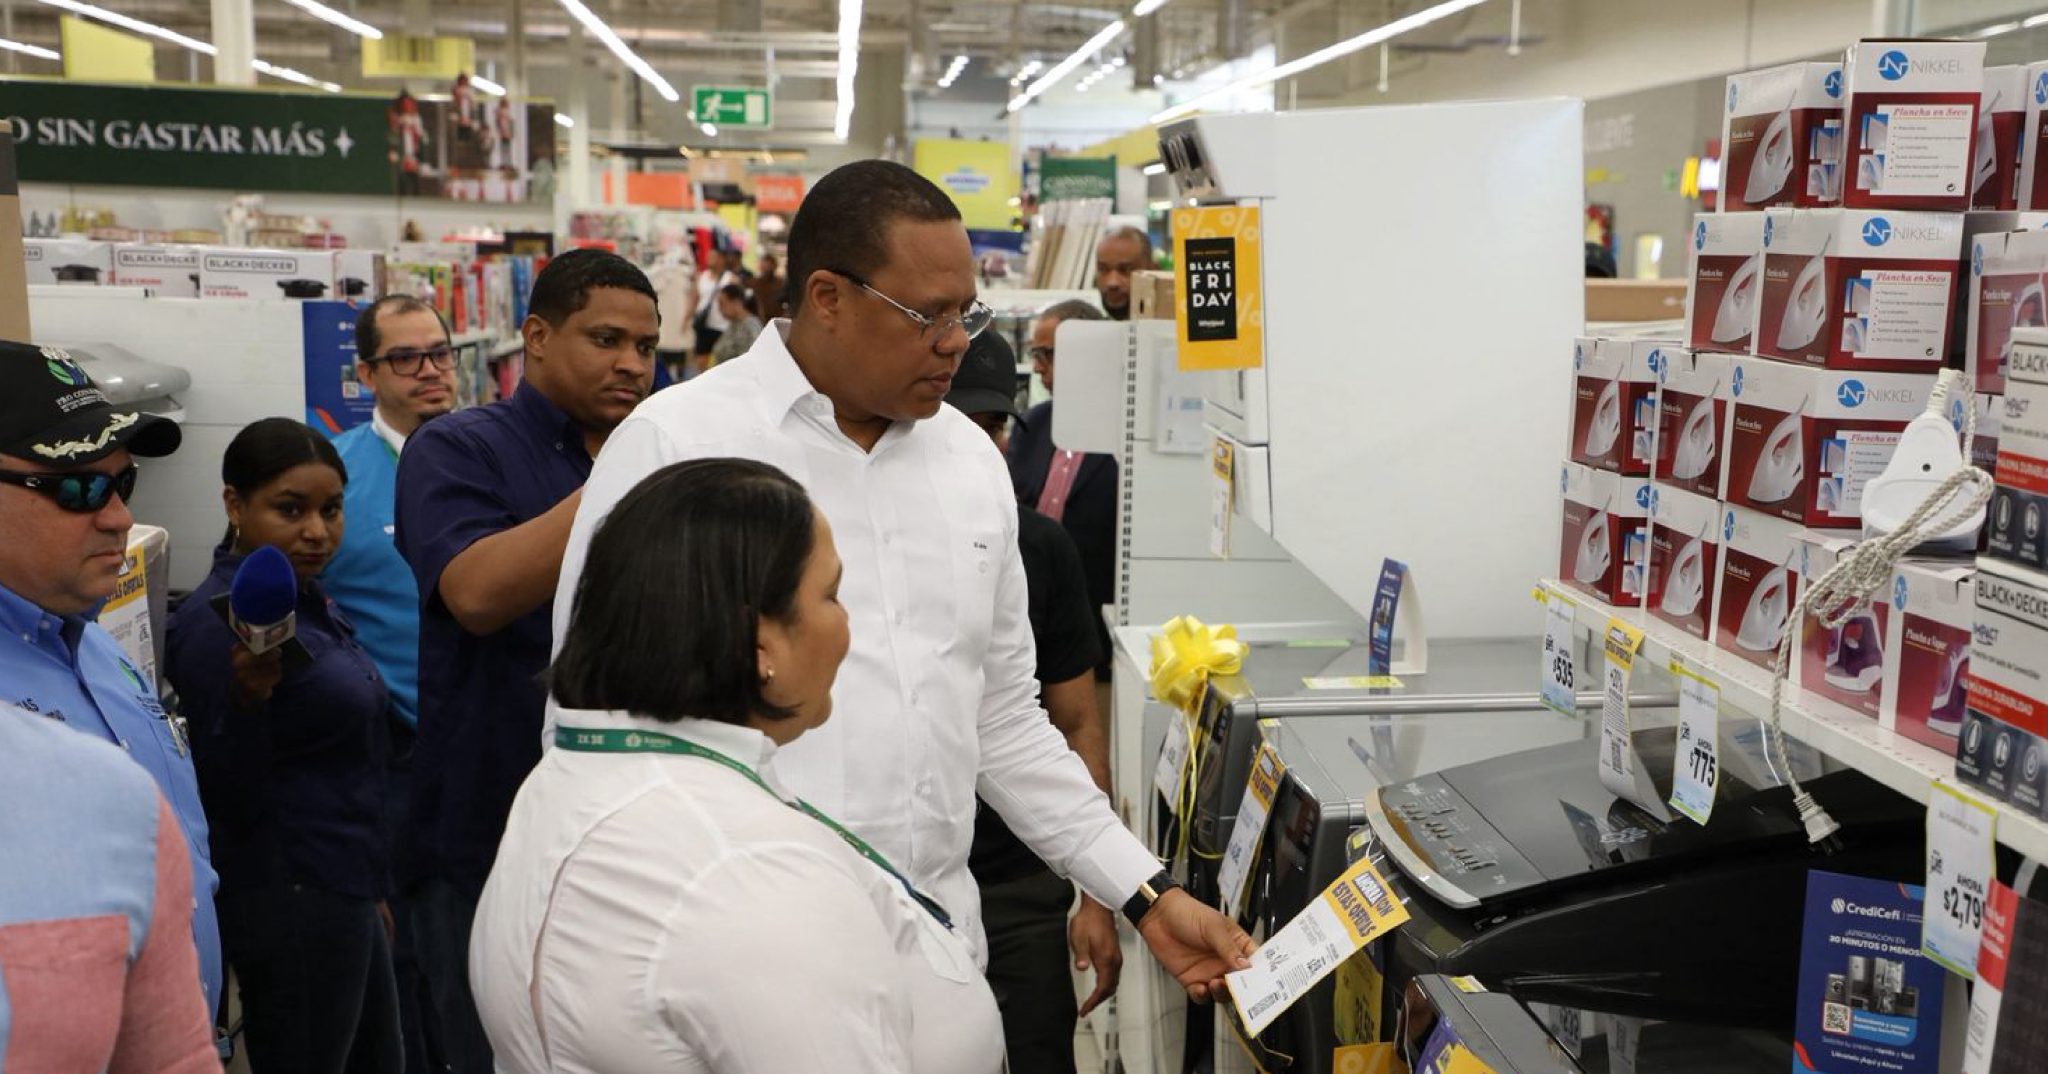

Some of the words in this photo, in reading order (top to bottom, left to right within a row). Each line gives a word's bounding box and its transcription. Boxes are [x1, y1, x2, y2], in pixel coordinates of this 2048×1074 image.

[37, 118, 96, 146] SIN
[104, 119, 244, 154] GASTAR
[252, 121, 326, 157] MÁS
[122, 254, 199, 266] BLACK+DECKE
[208, 257, 293, 271] BLACK+DECKER
[1189, 261, 1231, 271] BLACK
[1191, 273, 1231, 289] FRI
[1192, 292, 1232, 307] DAY
[1977, 579, 2048, 618] BLACK+DECKE
[1689, 747, 1716, 788] $775
[1957, 872, 1983, 895] AHORA
[1846, 902, 1902, 920] CrediCefi
[1841, 936, 1880, 951] MINUTOS
[1889, 945, 1922, 957] MENOS
